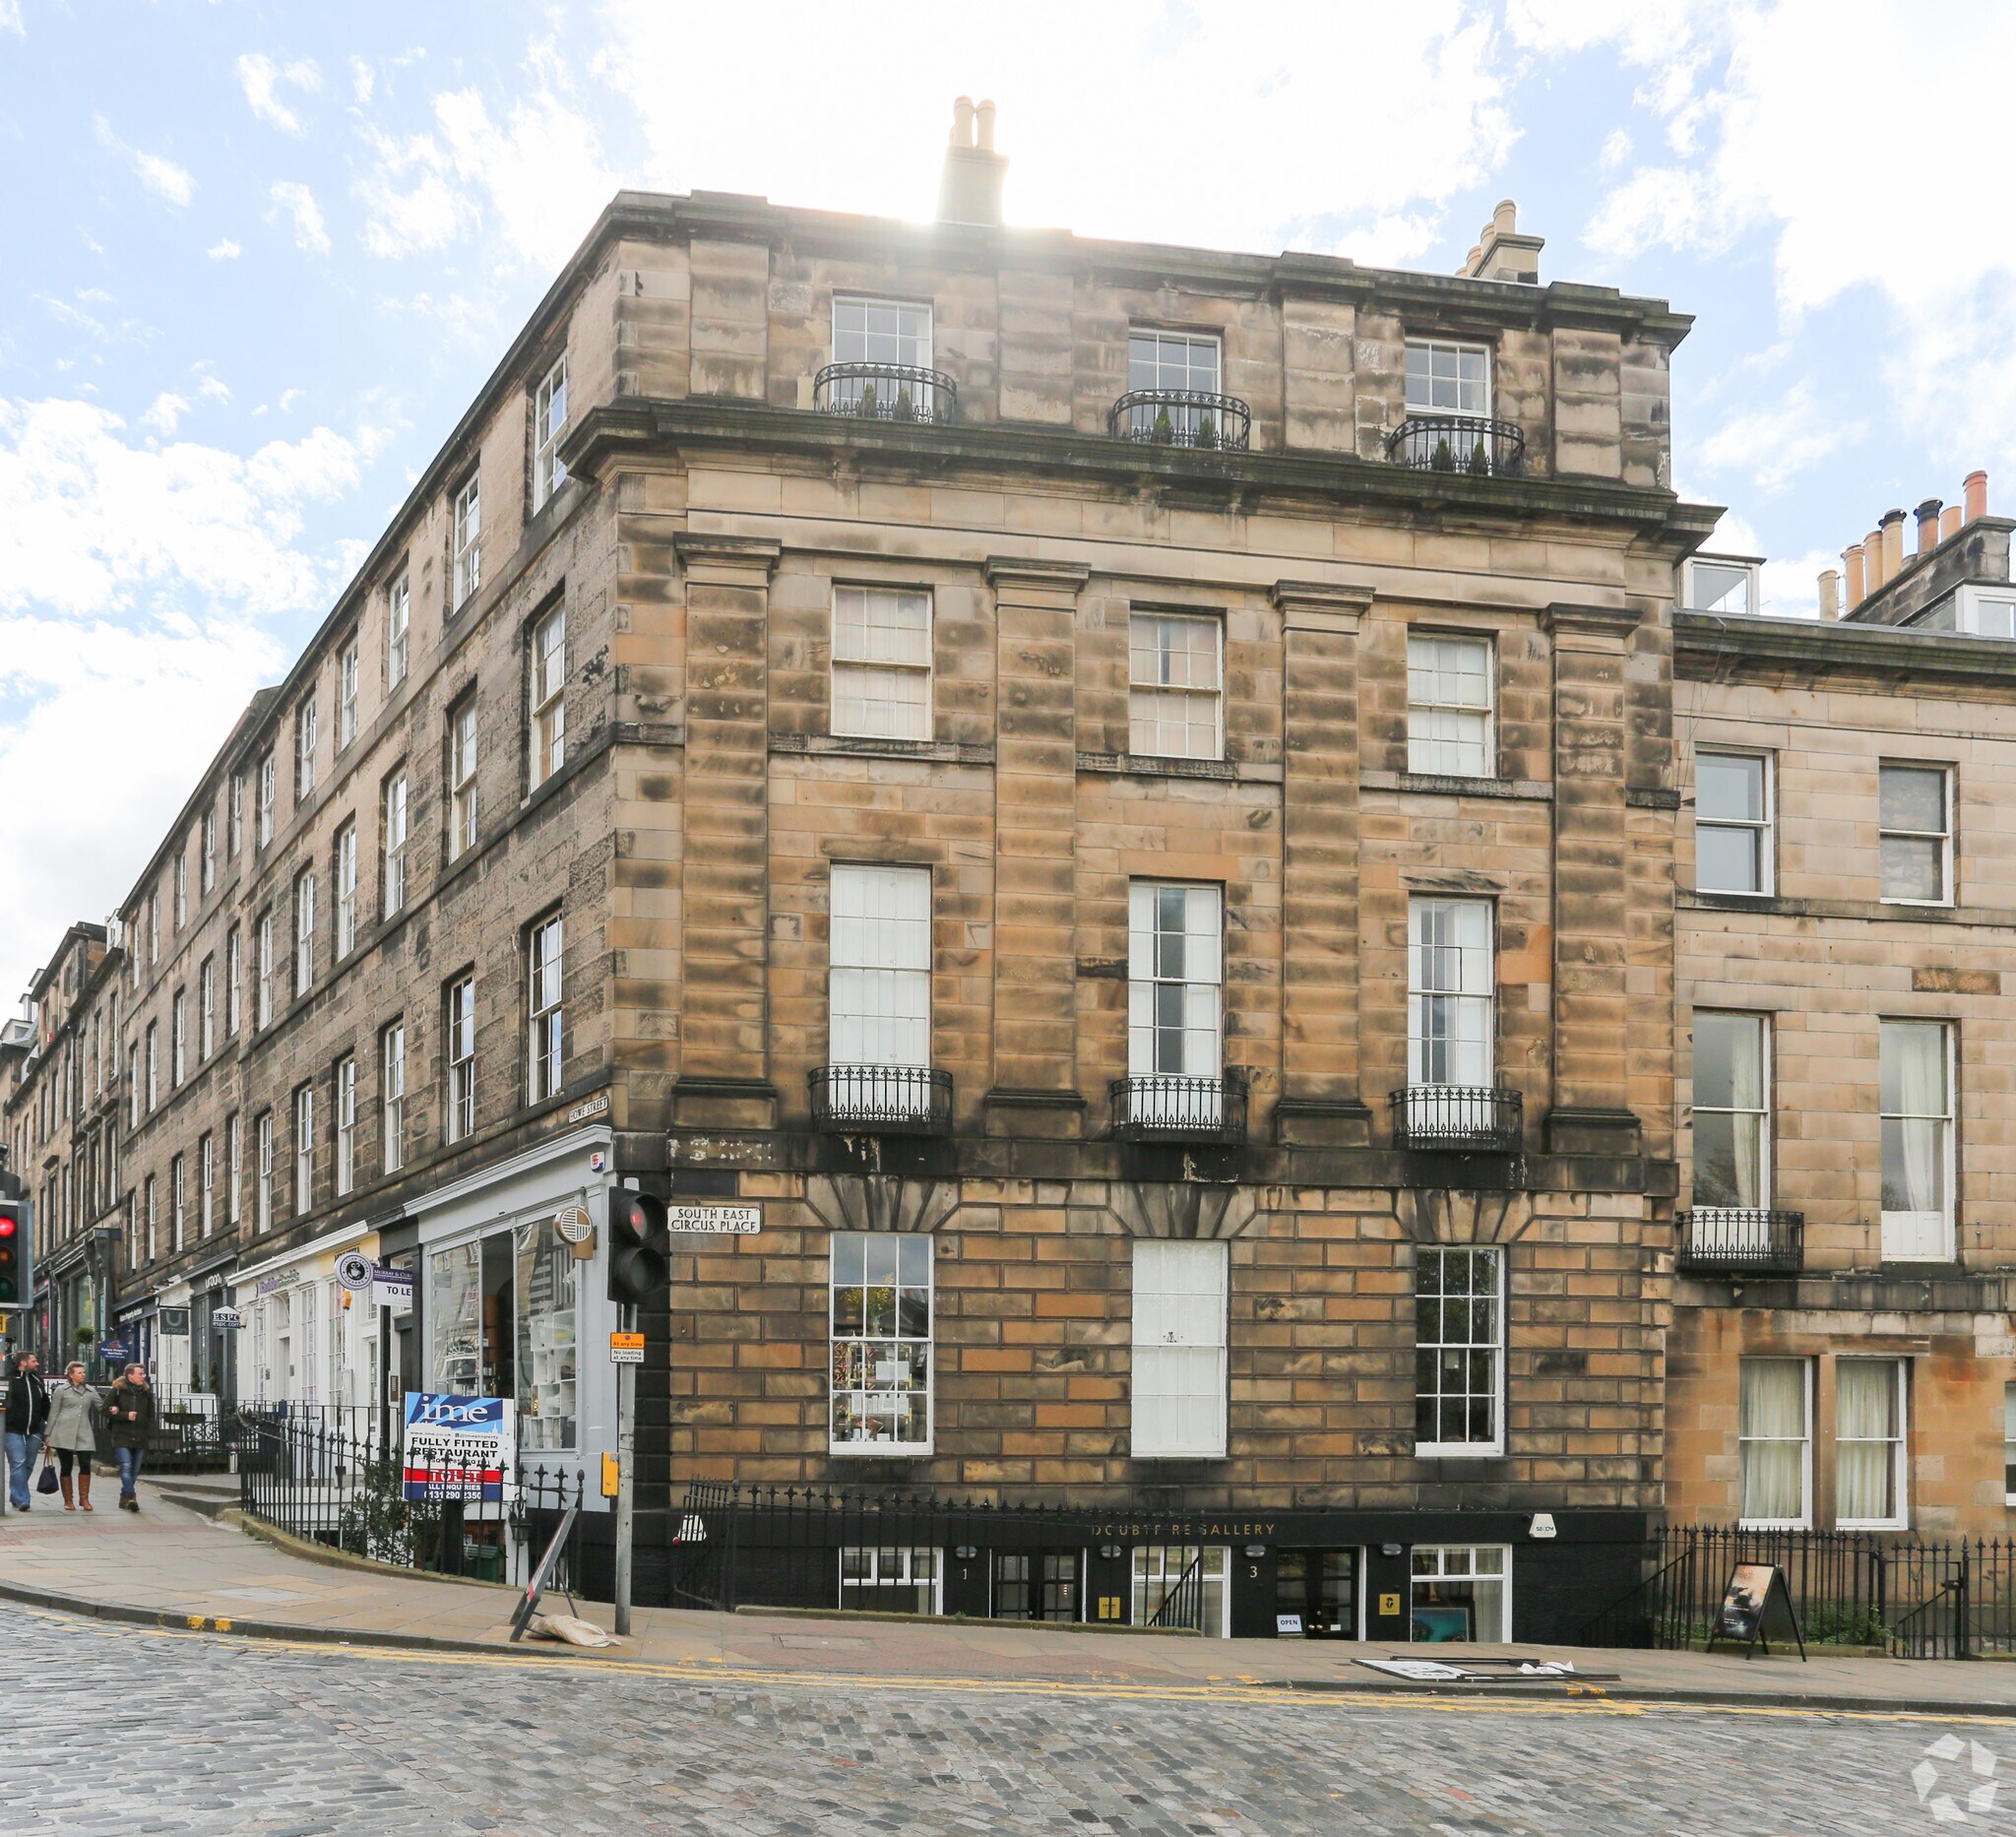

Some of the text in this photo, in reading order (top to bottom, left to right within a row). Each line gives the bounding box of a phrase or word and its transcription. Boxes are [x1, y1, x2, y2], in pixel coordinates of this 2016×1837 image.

[587, 1098, 607, 1113] STREET
[678, 1209, 751, 1221] SOUTH EAST
[671, 1220, 756, 1232] CIRCUS PLACE
[387, 1286, 399, 1295] TO
[421, 1396, 488, 1423] ime
[411, 1437, 498, 1448] FULLY FITTED
[413, 1447, 498, 1458] RESTAURANT
[429, 1470, 479, 1482] TO LET
[963, 1568, 967, 1579] 1
[1250, 1565, 1258, 1578] 3
